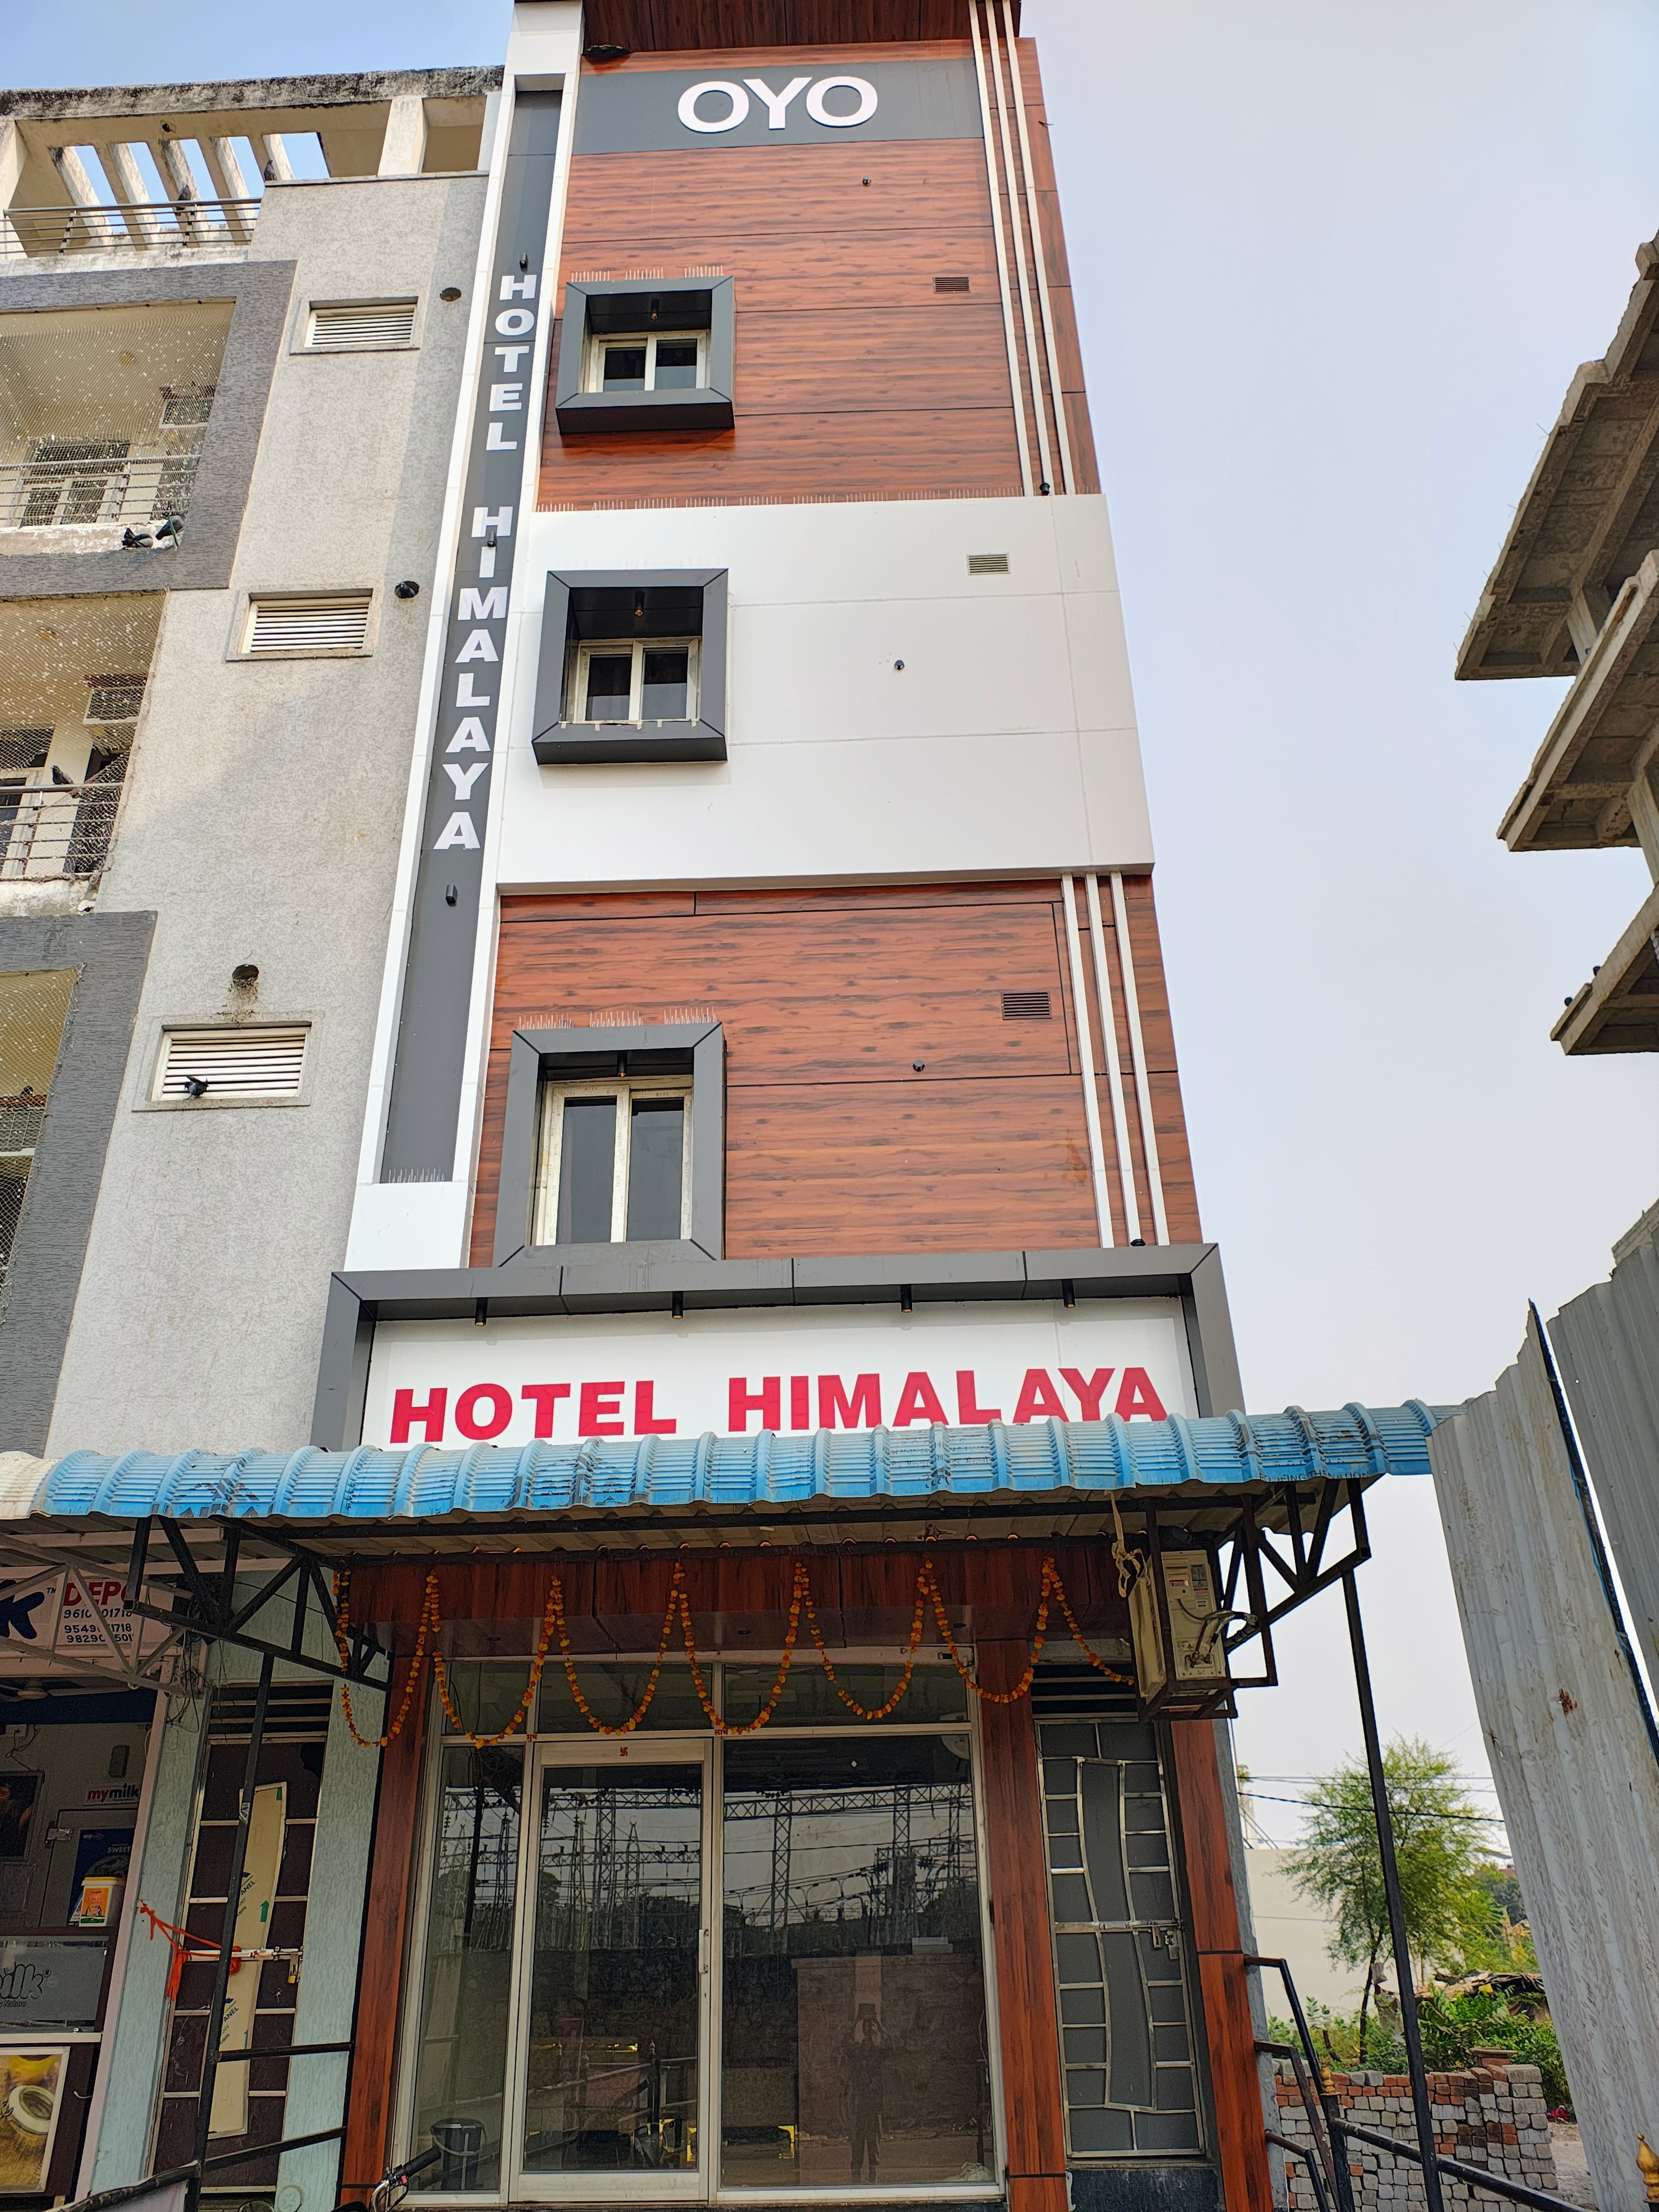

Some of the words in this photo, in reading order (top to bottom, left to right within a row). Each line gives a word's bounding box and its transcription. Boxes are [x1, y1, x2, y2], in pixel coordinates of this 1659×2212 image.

[678, 76, 878, 133] OYO
[485, 274, 537, 451] HOTEL
[433, 506, 513, 850] HIMALAYA
[390, 1381, 676, 1443] HOTEL
[729, 1368, 1166, 1431] HIMALAYA
[63, 1581, 127, 1607] DEP
